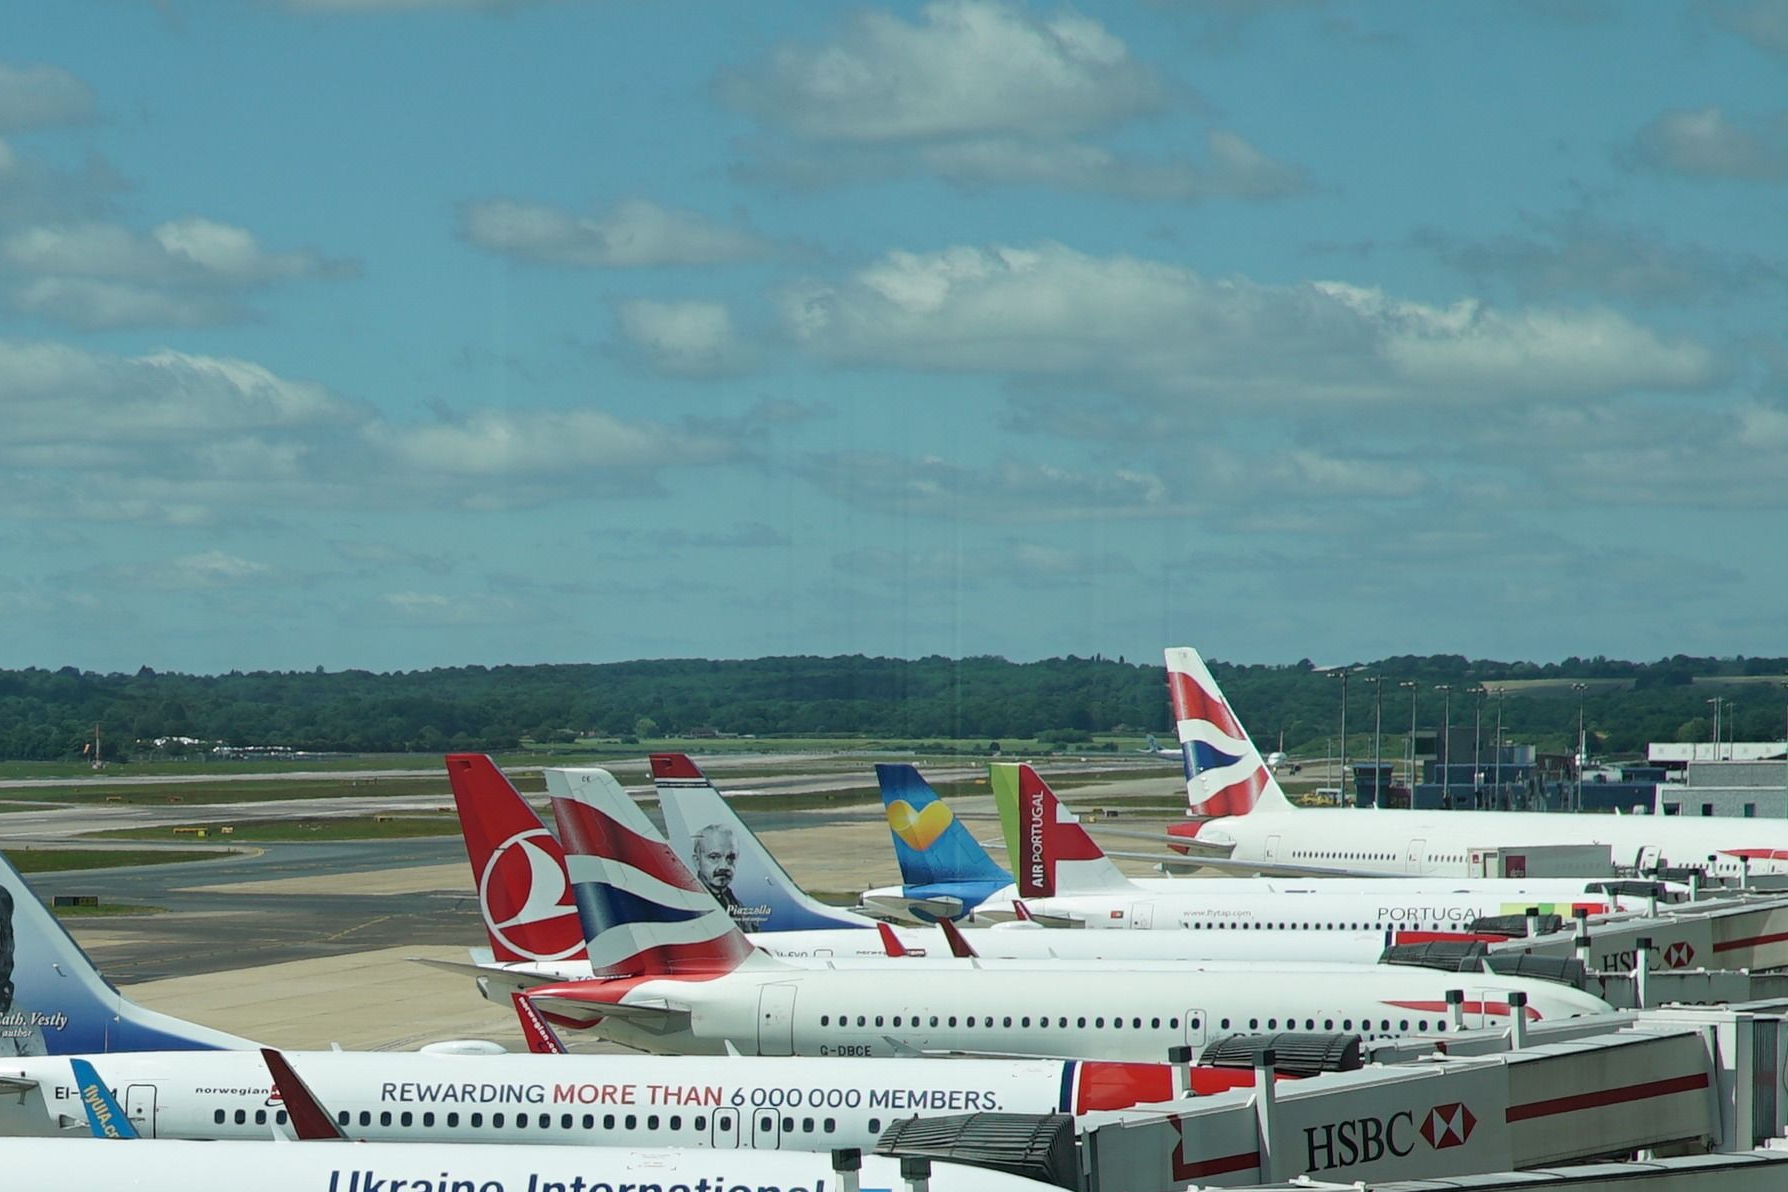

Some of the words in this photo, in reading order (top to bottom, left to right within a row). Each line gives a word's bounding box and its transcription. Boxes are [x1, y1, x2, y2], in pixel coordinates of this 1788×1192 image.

[1031, 790, 1044, 862] PORTUGAL
[1031, 865, 1044, 888] AIR
[1602, 946, 1661, 972] HSC
[30, 1011, 68, 1031] Vestly
[195, 1086, 269, 1096] norwegian
[381, 1082, 545, 1103] REWARDING
[553, 1084, 636, 1106] MORE
[647, 1084, 723, 1107] THAN
[869, 1089, 1004, 1111] MEMBERS.
[1303, 1110, 1415, 1173] HSBC
